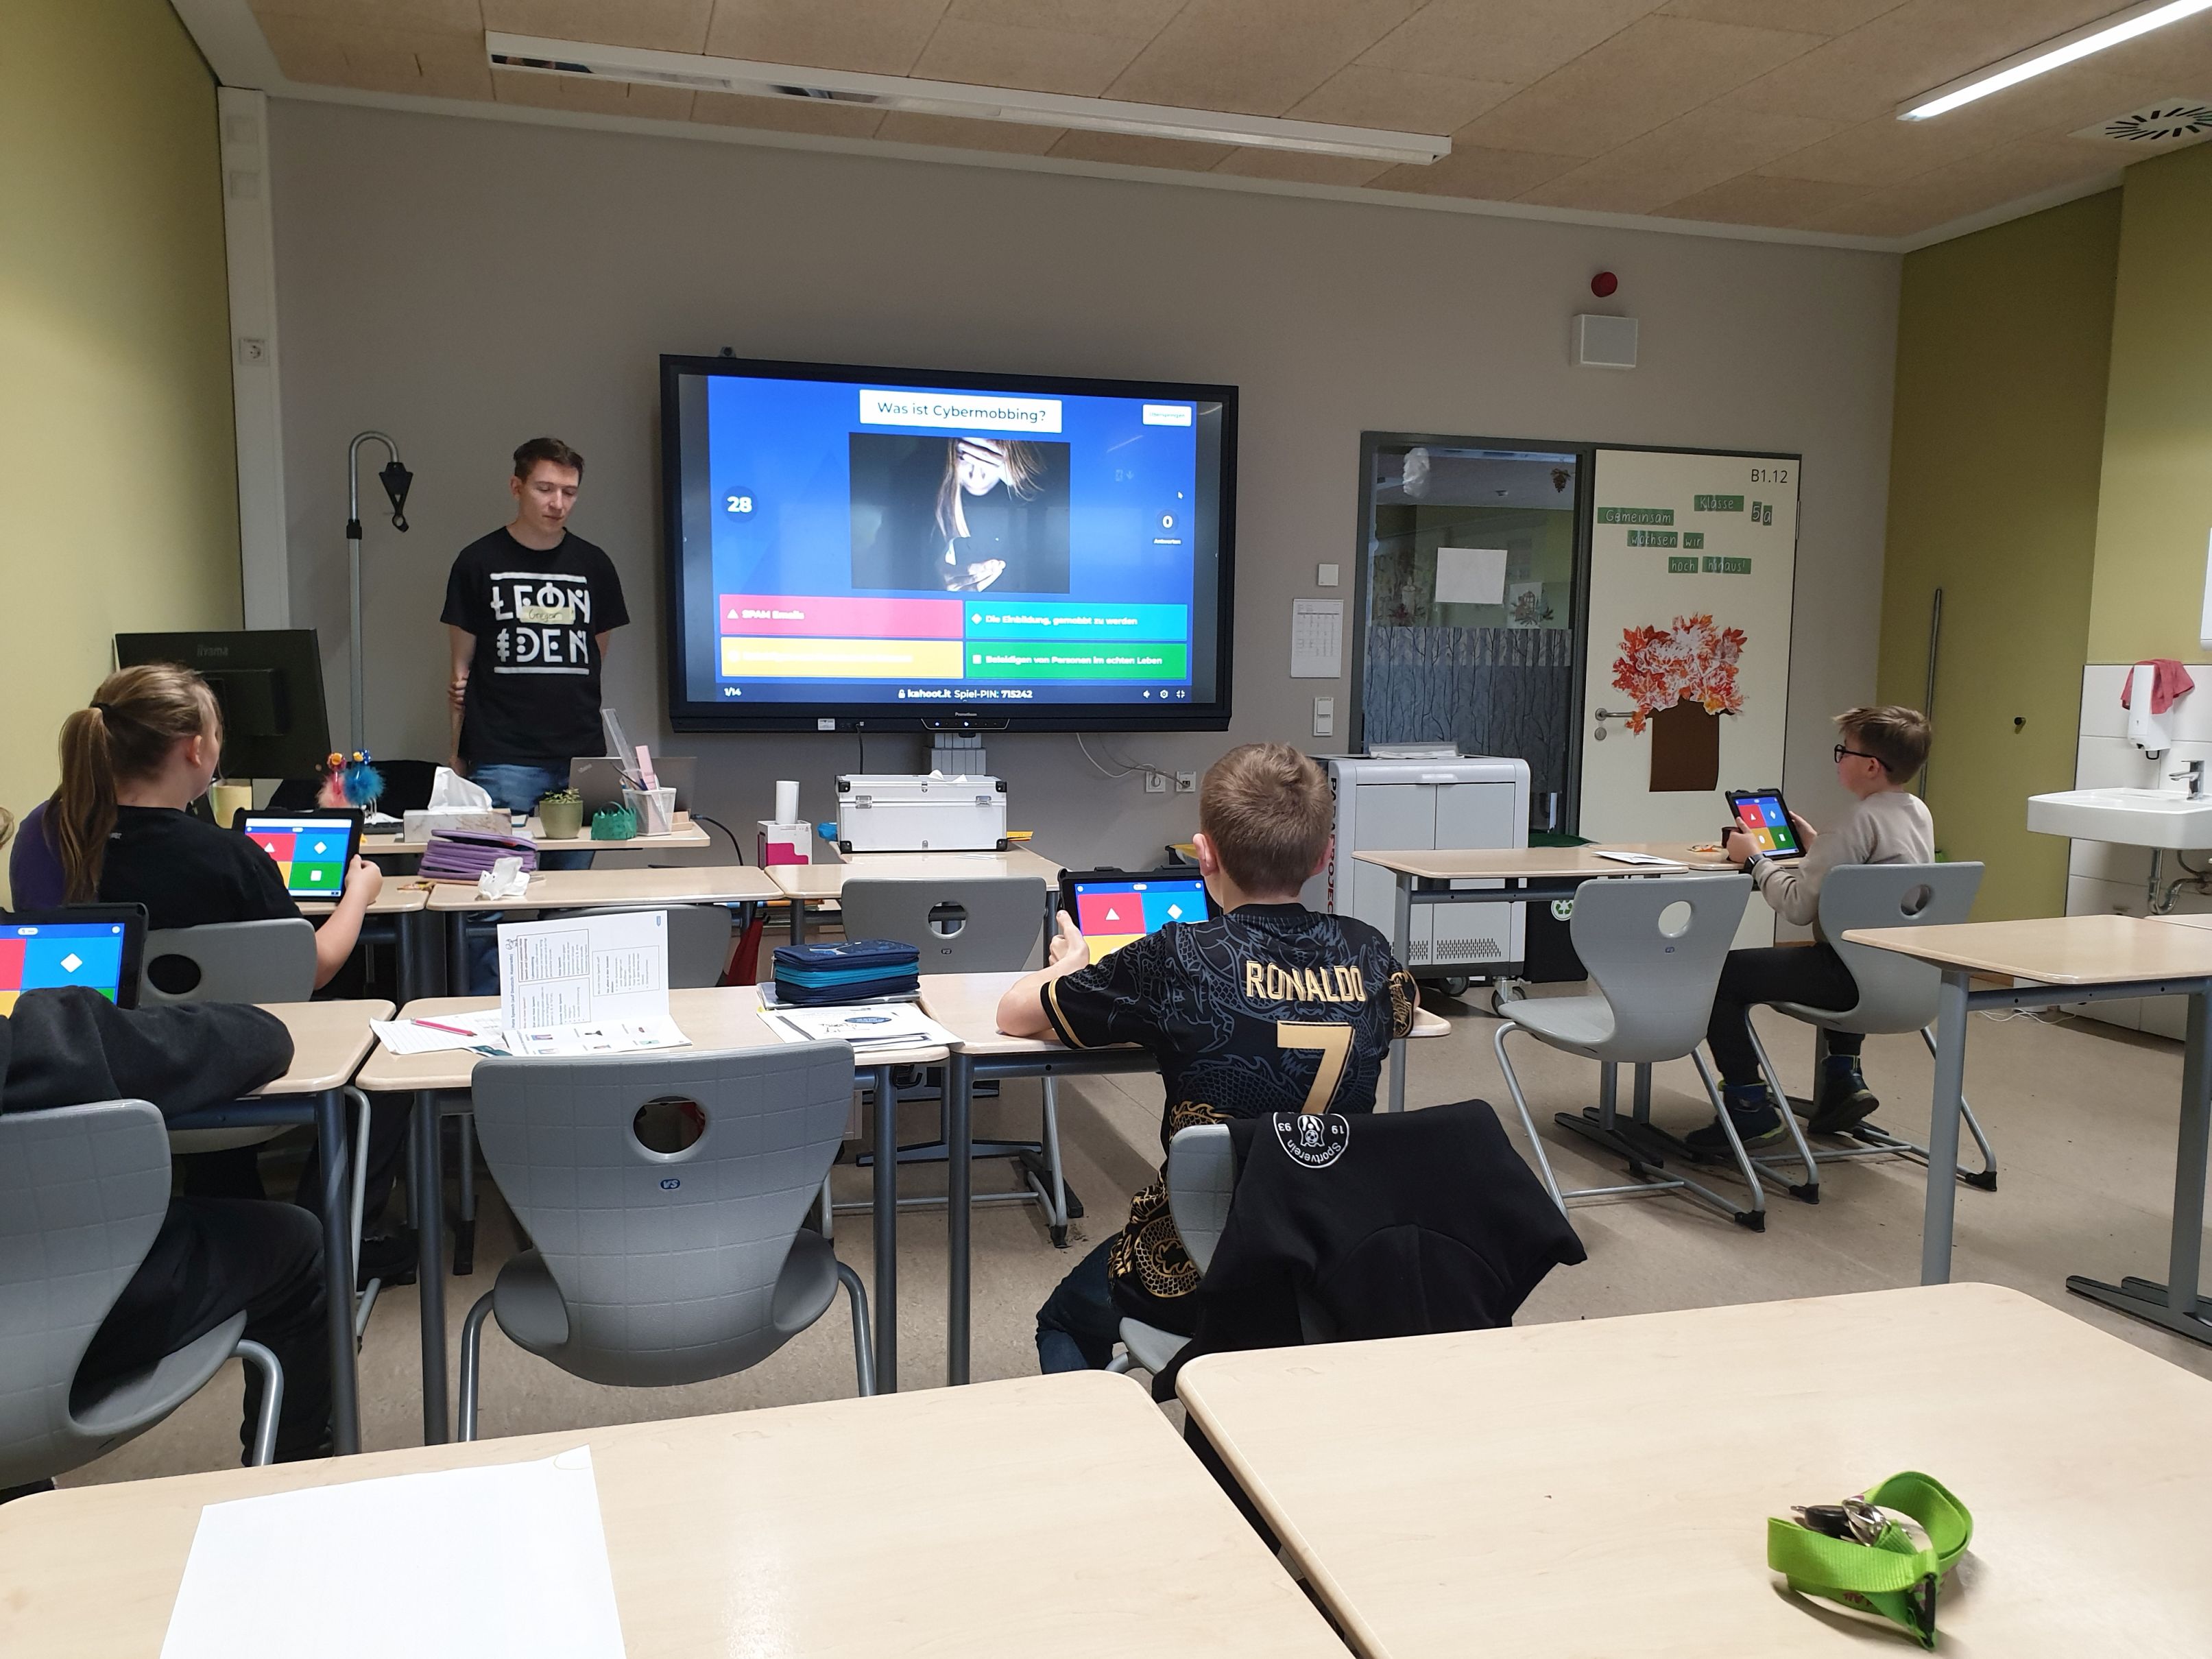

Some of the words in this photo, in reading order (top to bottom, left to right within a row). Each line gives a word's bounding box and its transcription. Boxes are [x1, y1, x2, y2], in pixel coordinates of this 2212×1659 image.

[877, 402, 908, 414] Was
[913, 403, 928, 416] ist
[933, 405, 1046, 424] Cybermobbing?
[1751, 468, 1788, 484] B1.12
[727, 496, 752, 513] 28
[1699, 497, 1734, 510] Klasse
[1162, 515, 1173, 528] 0
[1605, 509, 1672, 524] Gemeinsam
[1685, 536, 1702, 547] wir
[1671, 560, 1695, 572] hoch
[741, 609, 771, 619] SPAM
[985, 614, 1000, 623] Die
[1002, 614, 1051, 625] Einbildung,
[1053, 616, 1092, 626] gemobbt
[1106, 617, 1138, 625] werden
[985, 654, 1032, 665] Beleidigen
[1051, 656, 1092, 665] Personen
[1093, 656, 1105, 665] im
[1106, 656, 1135, 665] echten
[1137, 656, 1163, 665] Leben
[907, 689, 952, 699] kahoot.it
[954, 689, 999, 700] Spiel-PIN:
[1001, 690, 1033, 699] 715242
[1246, 960, 1367, 1002] RONALDO
[1277, 1020, 1356, 1114] 7
[1277, 1122, 1292, 1132] 93
[1331, 1125, 1345, 1135] 19
[1287, 1138, 1342, 1165] Sportverein
[663, 1180, 679, 1189] VS
